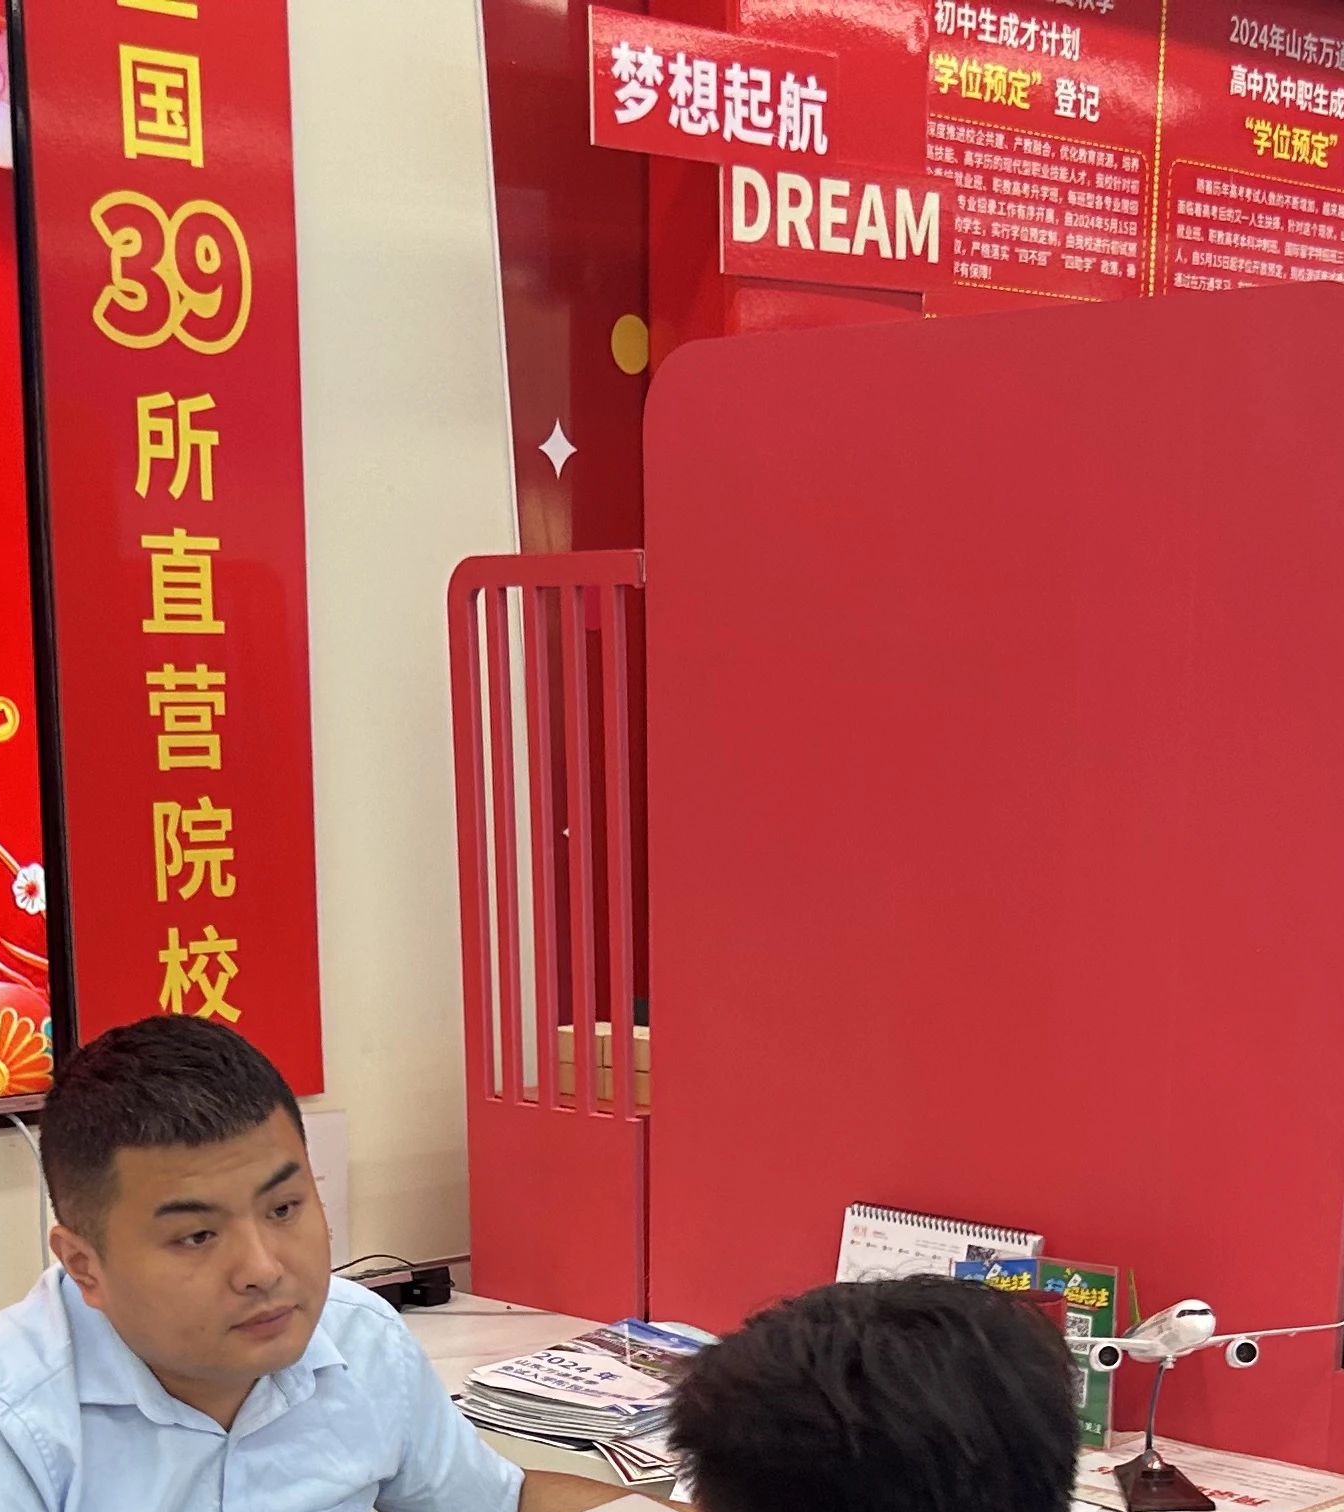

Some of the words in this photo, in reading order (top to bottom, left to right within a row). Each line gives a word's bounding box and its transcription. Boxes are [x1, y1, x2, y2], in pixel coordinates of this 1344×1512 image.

[933, 0, 1082, 62] 初中生成才计划
[610, 40, 829, 156] 梦想起航
[1054, 78, 1100, 123] 登记
[731, 164, 941, 264] DREAM
[90, 0, 252, 1021] 国39所直营院校
